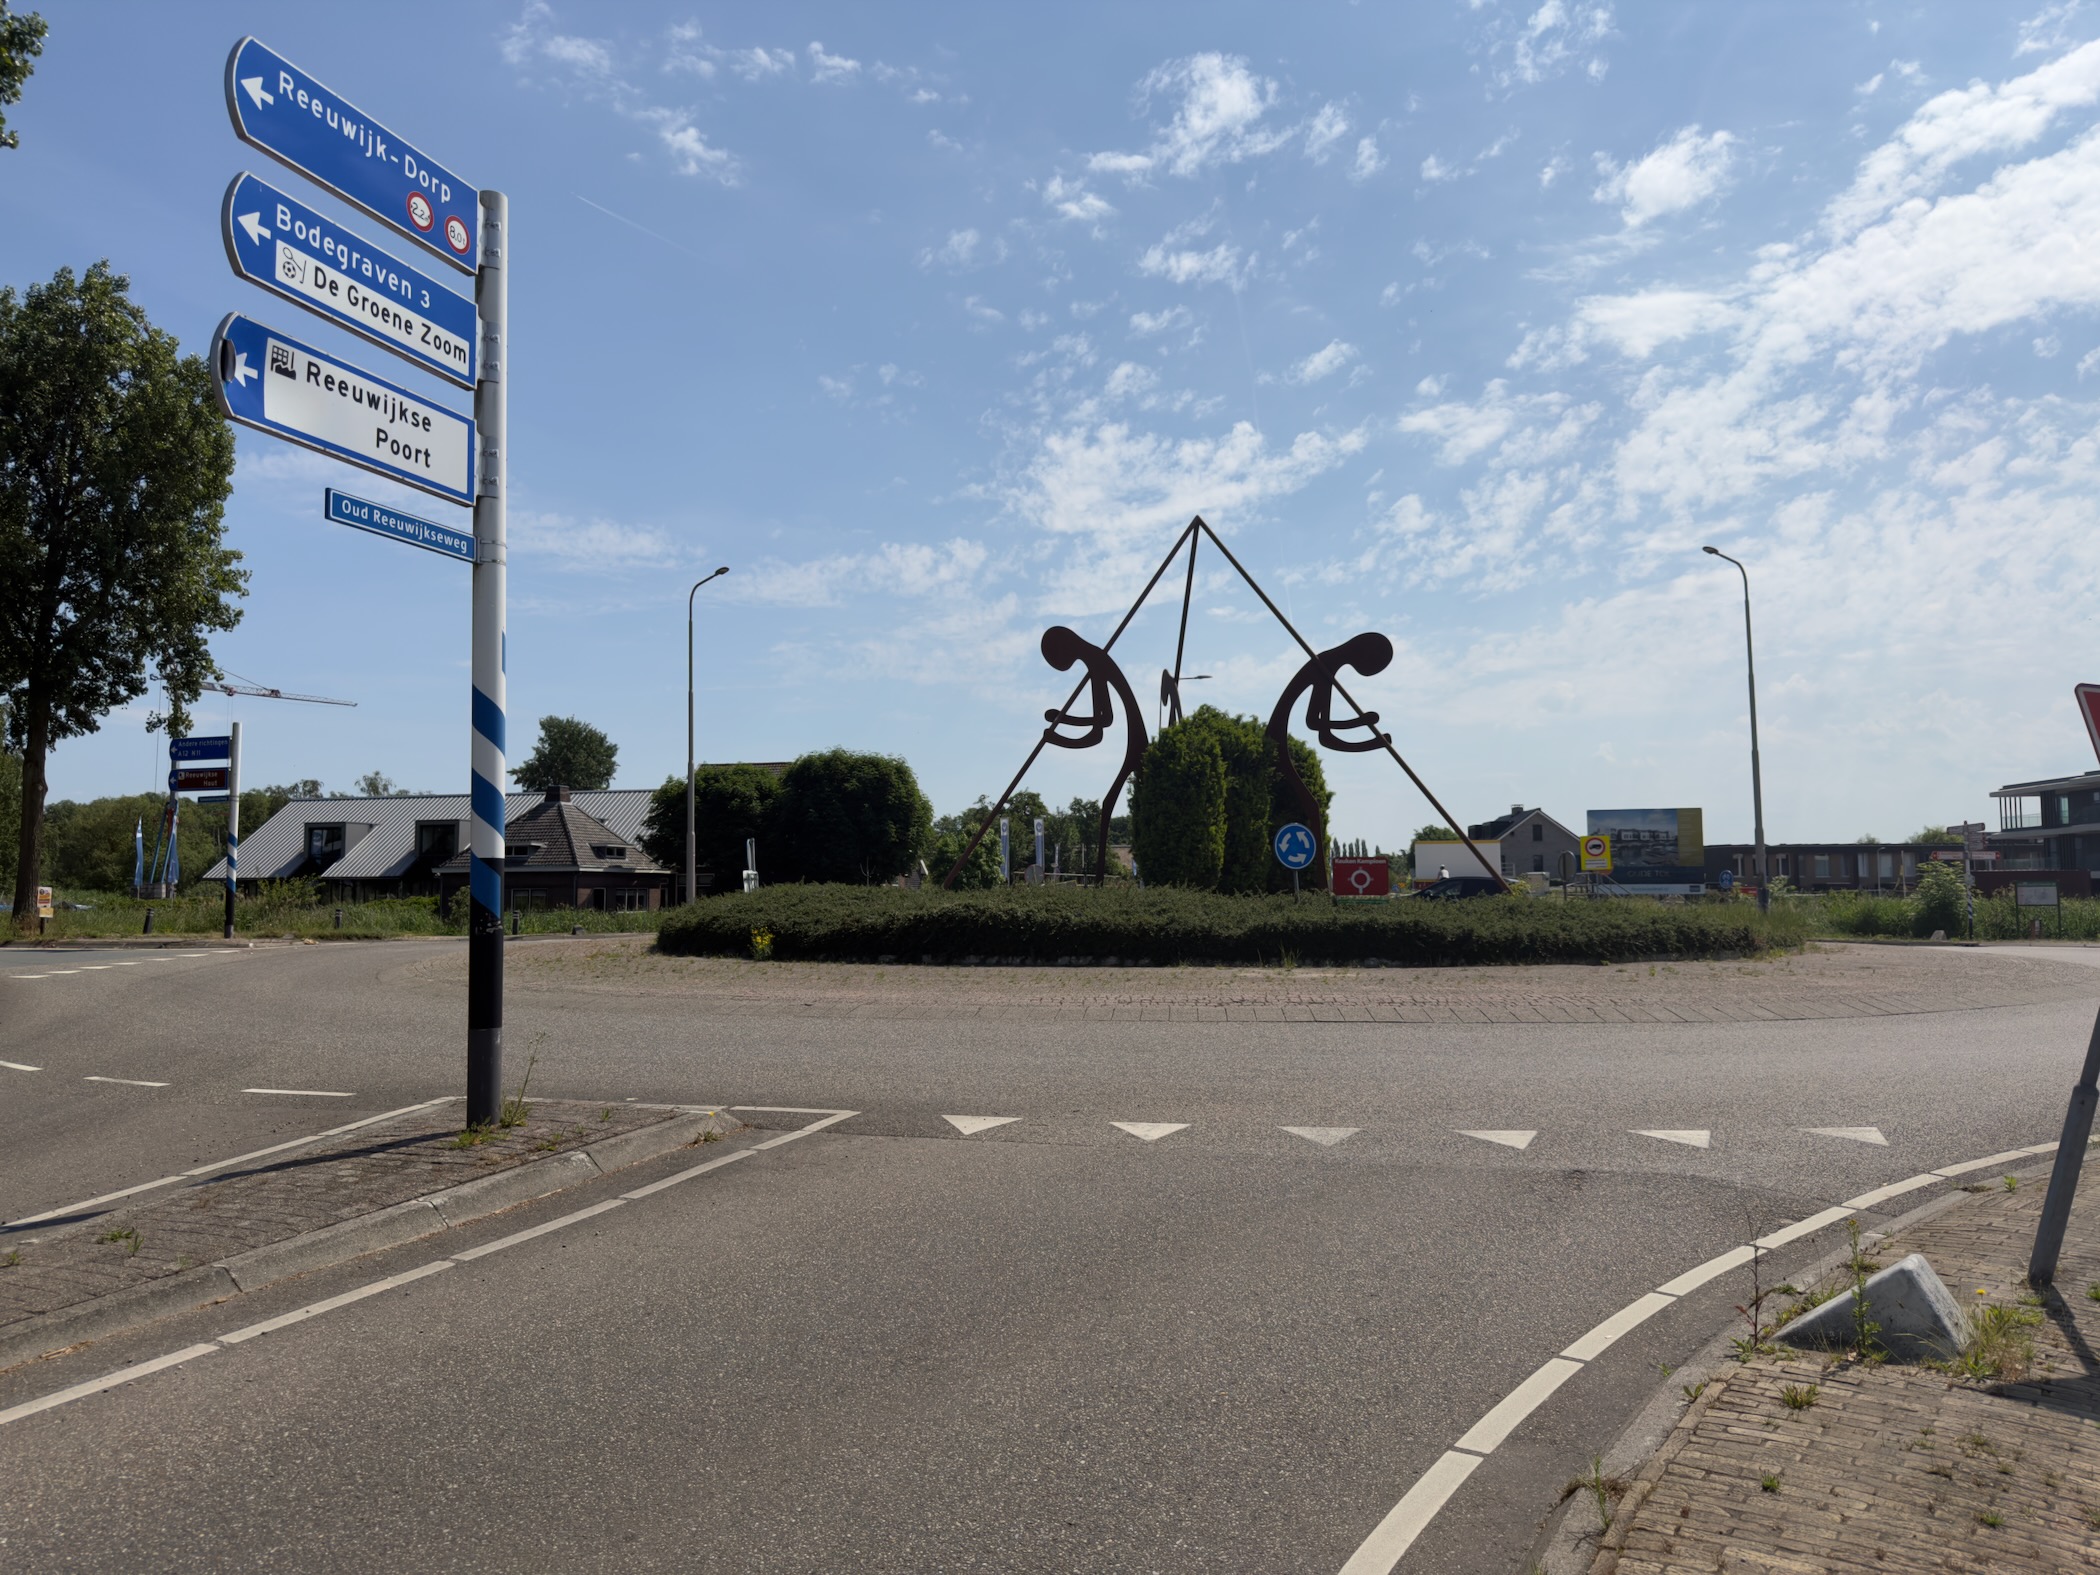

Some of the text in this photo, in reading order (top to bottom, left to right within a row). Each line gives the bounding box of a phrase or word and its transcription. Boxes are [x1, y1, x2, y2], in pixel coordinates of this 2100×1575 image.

[278, 70, 451, 203] Reeuwijk-Dorp
[276, 203, 430, 309] Bodegraven 3
[314, 265, 467, 364] De Groene Zoom
[306, 360, 432, 433] Reeuwijkse
[376, 428, 431, 468] Poort
[341, 499, 468, 554] Oud Reeuwijkseweg
[199, 739, 228, 747] richtingen
